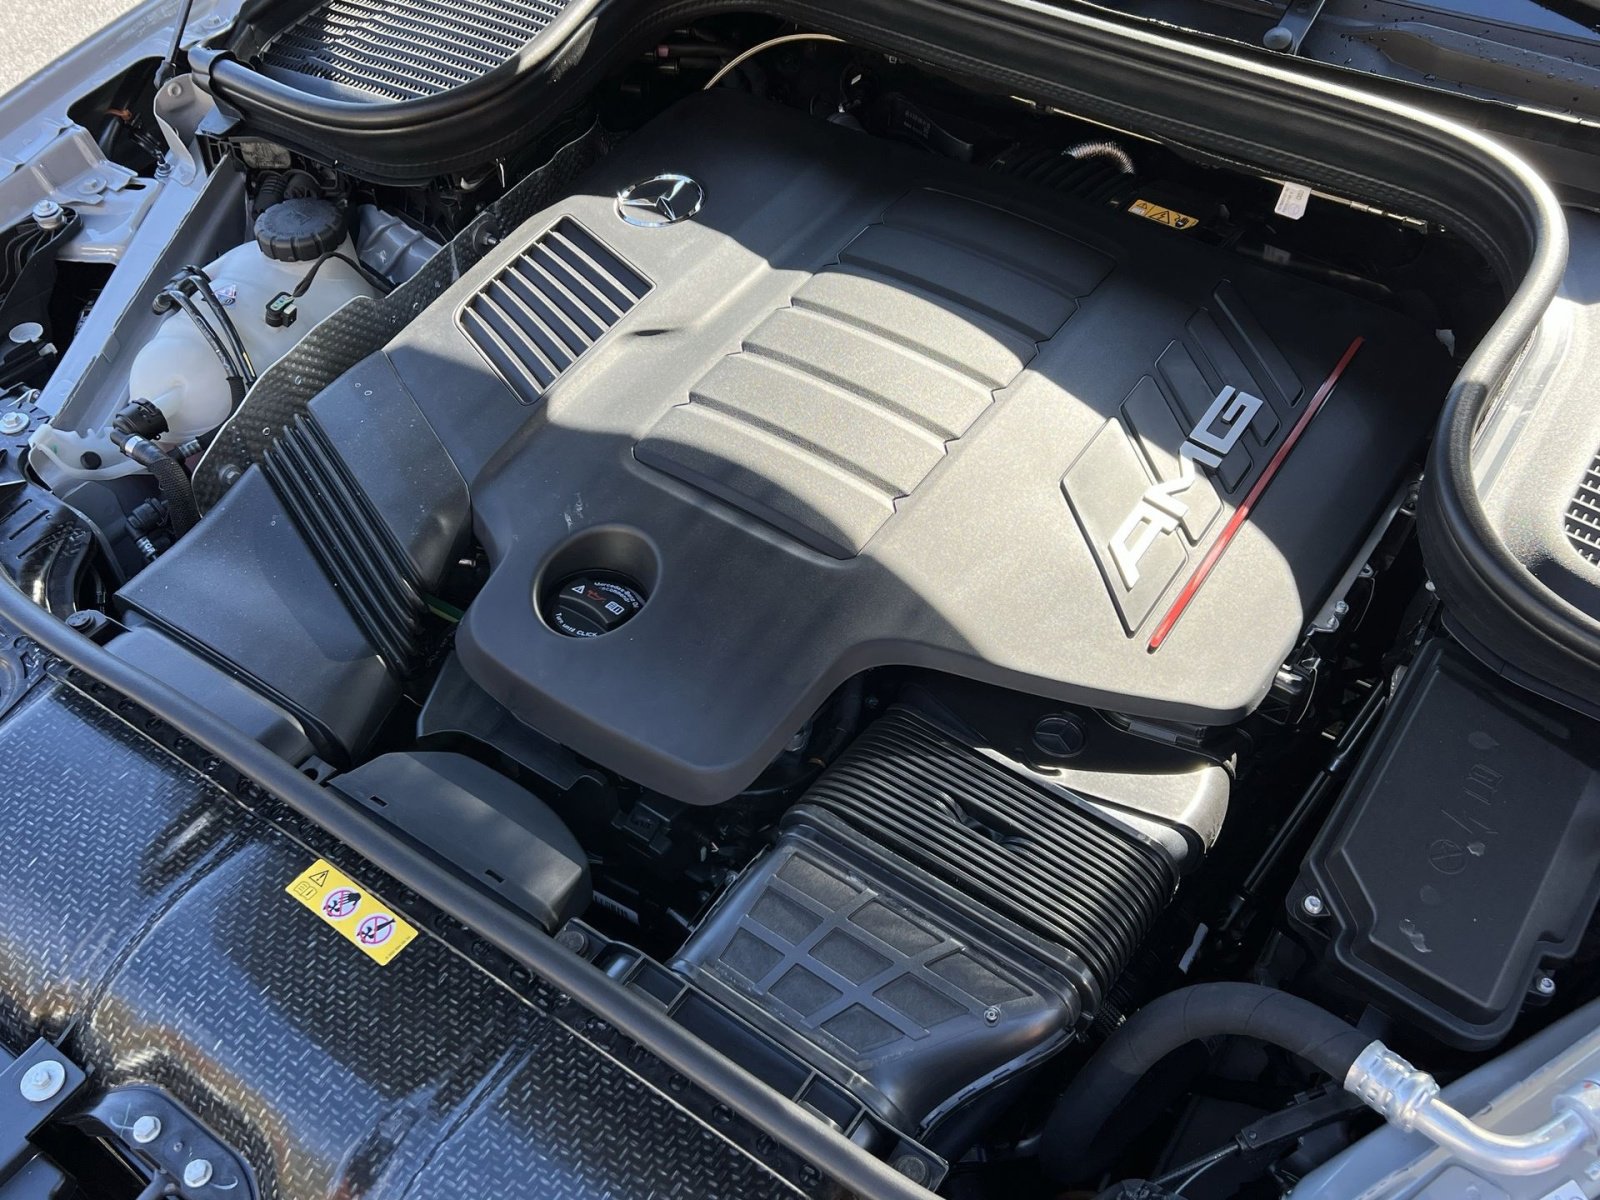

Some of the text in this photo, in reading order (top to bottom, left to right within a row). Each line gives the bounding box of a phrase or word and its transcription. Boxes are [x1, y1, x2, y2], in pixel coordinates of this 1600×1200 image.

[1109, 385, 1264, 590] AMG
[555, 612, 564, 624] Turn
[562, 623, 576, 633] until
